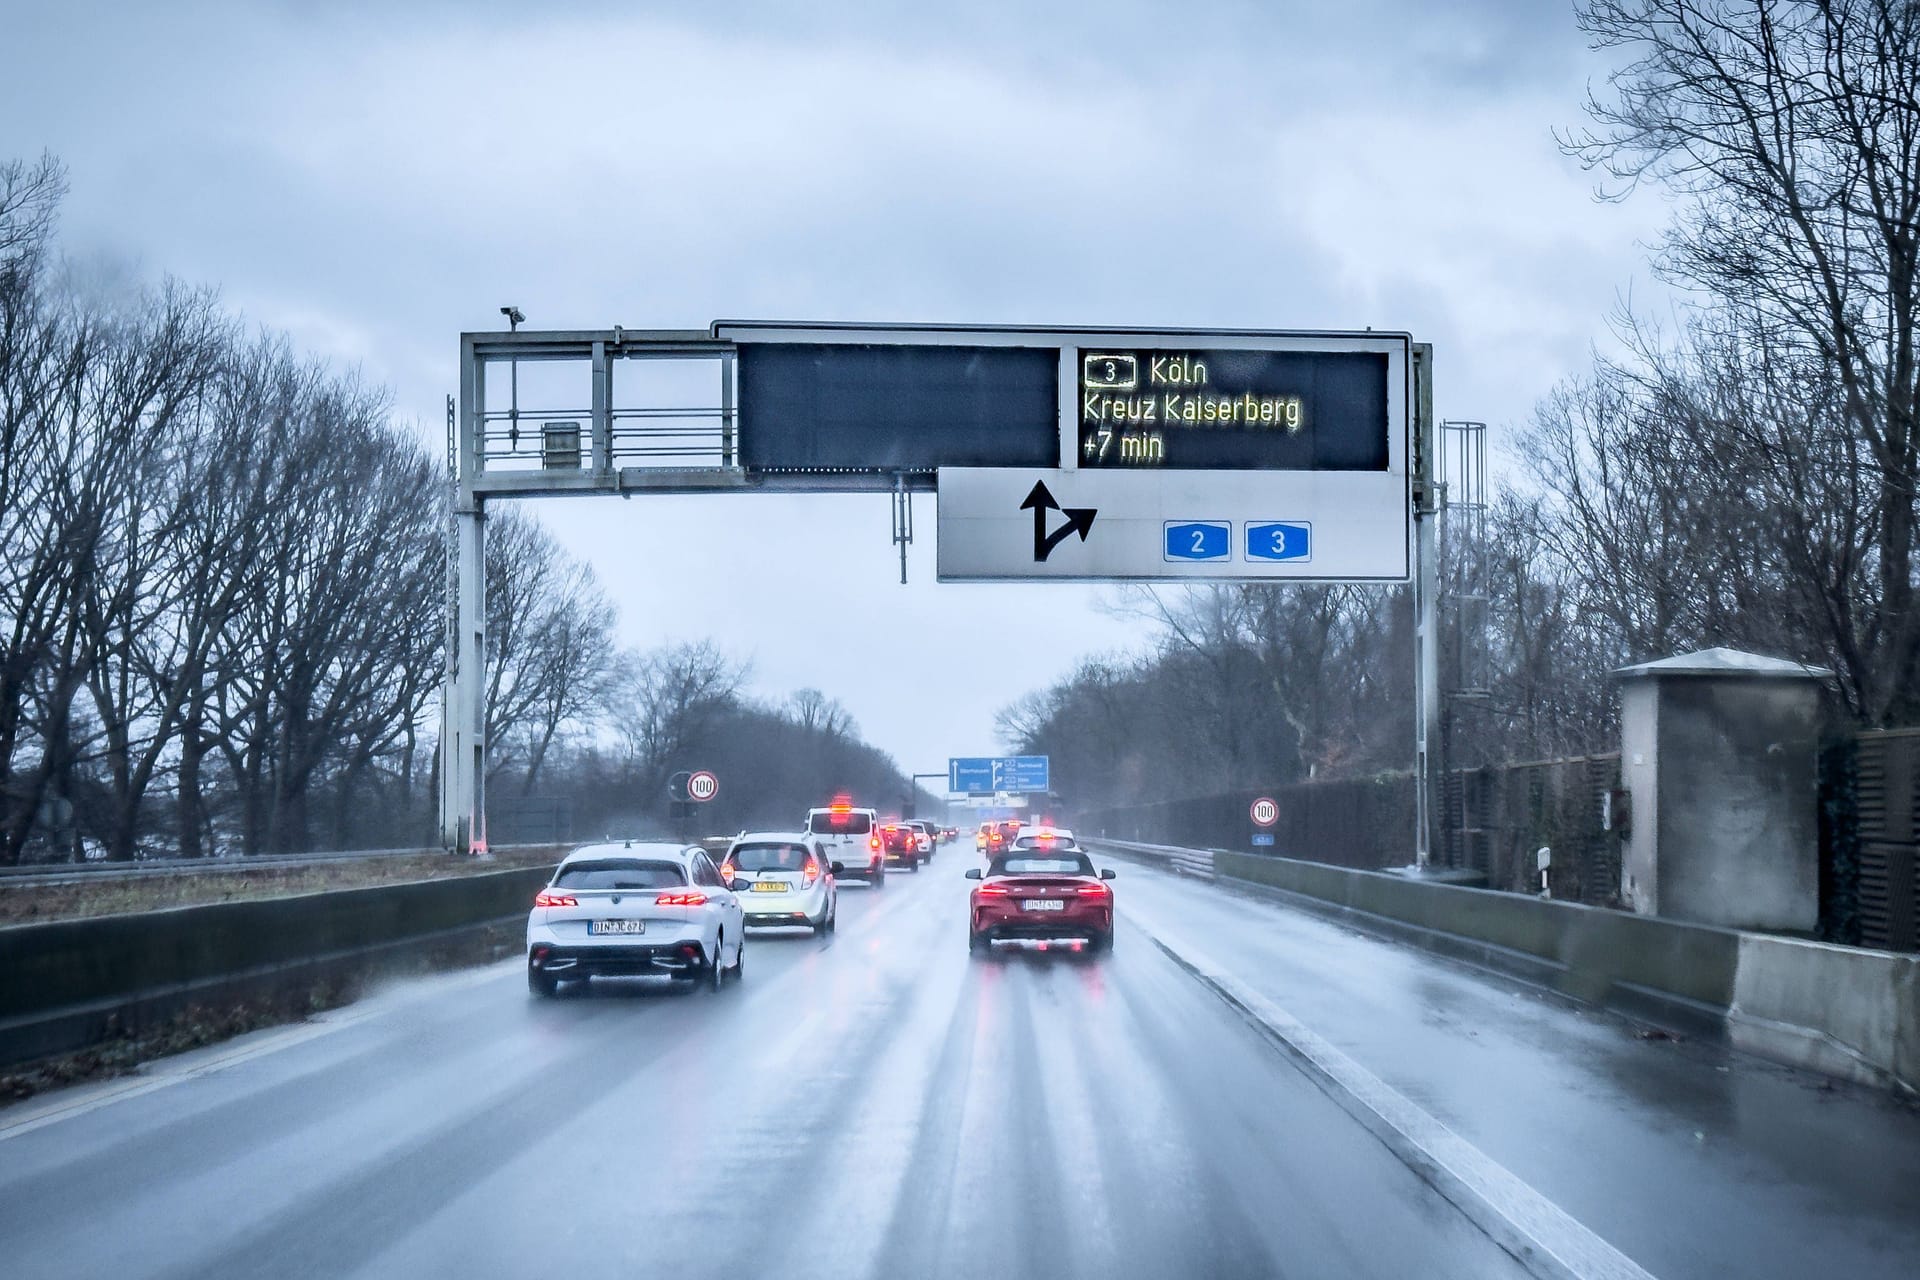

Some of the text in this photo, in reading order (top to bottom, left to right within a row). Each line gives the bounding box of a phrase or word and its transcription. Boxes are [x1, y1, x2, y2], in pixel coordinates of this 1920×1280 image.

[1104, 356, 1207, 383] 3 Köln
[1084, 393, 1301, 428] Kreuz Kaiserberg
[1084, 431, 1162, 458] +7 min
[1191, 530, 1205, 553] 2
[1271, 530, 1285, 554] 3
[695, 780, 713, 793] 100
[1257, 805, 1273, 818] 100
